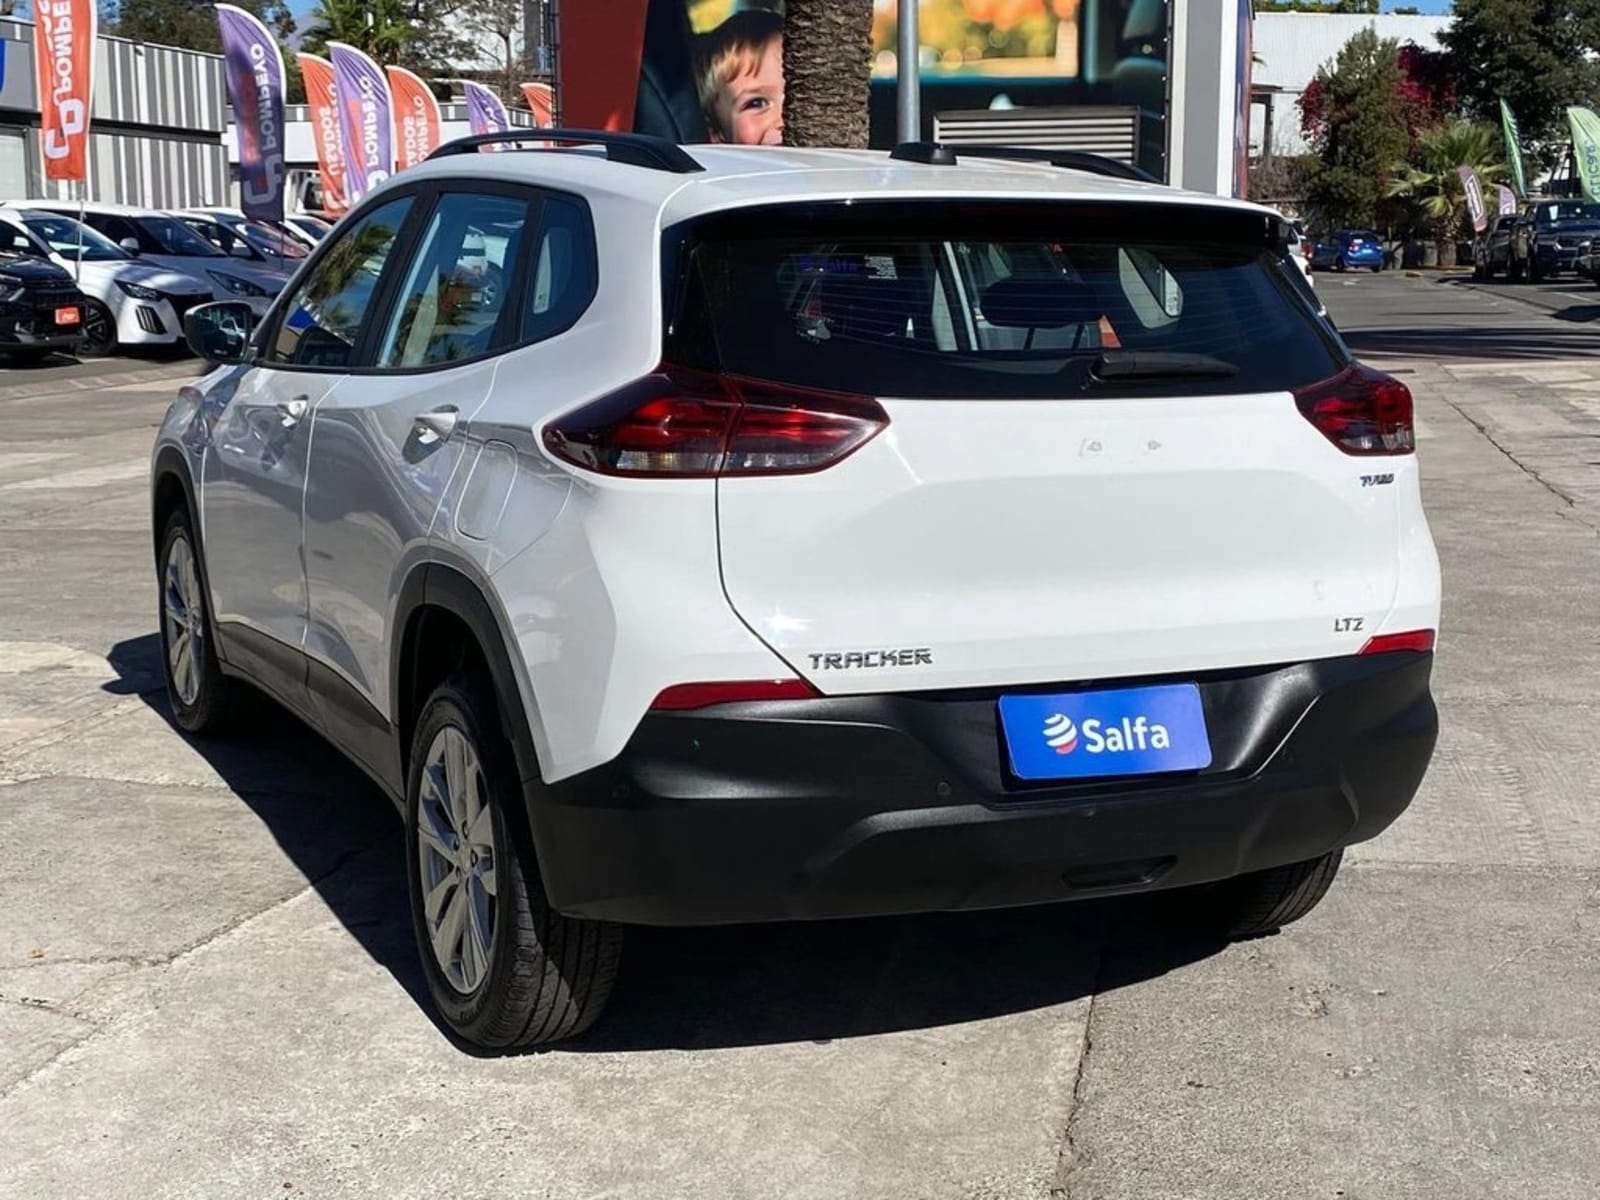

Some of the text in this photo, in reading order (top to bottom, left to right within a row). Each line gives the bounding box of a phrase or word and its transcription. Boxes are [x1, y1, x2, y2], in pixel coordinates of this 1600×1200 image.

[1335, 617, 1364, 632] LTZ
[808, 648, 933, 670] TRACKER
[1082, 716, 1170, 753] Salfa
